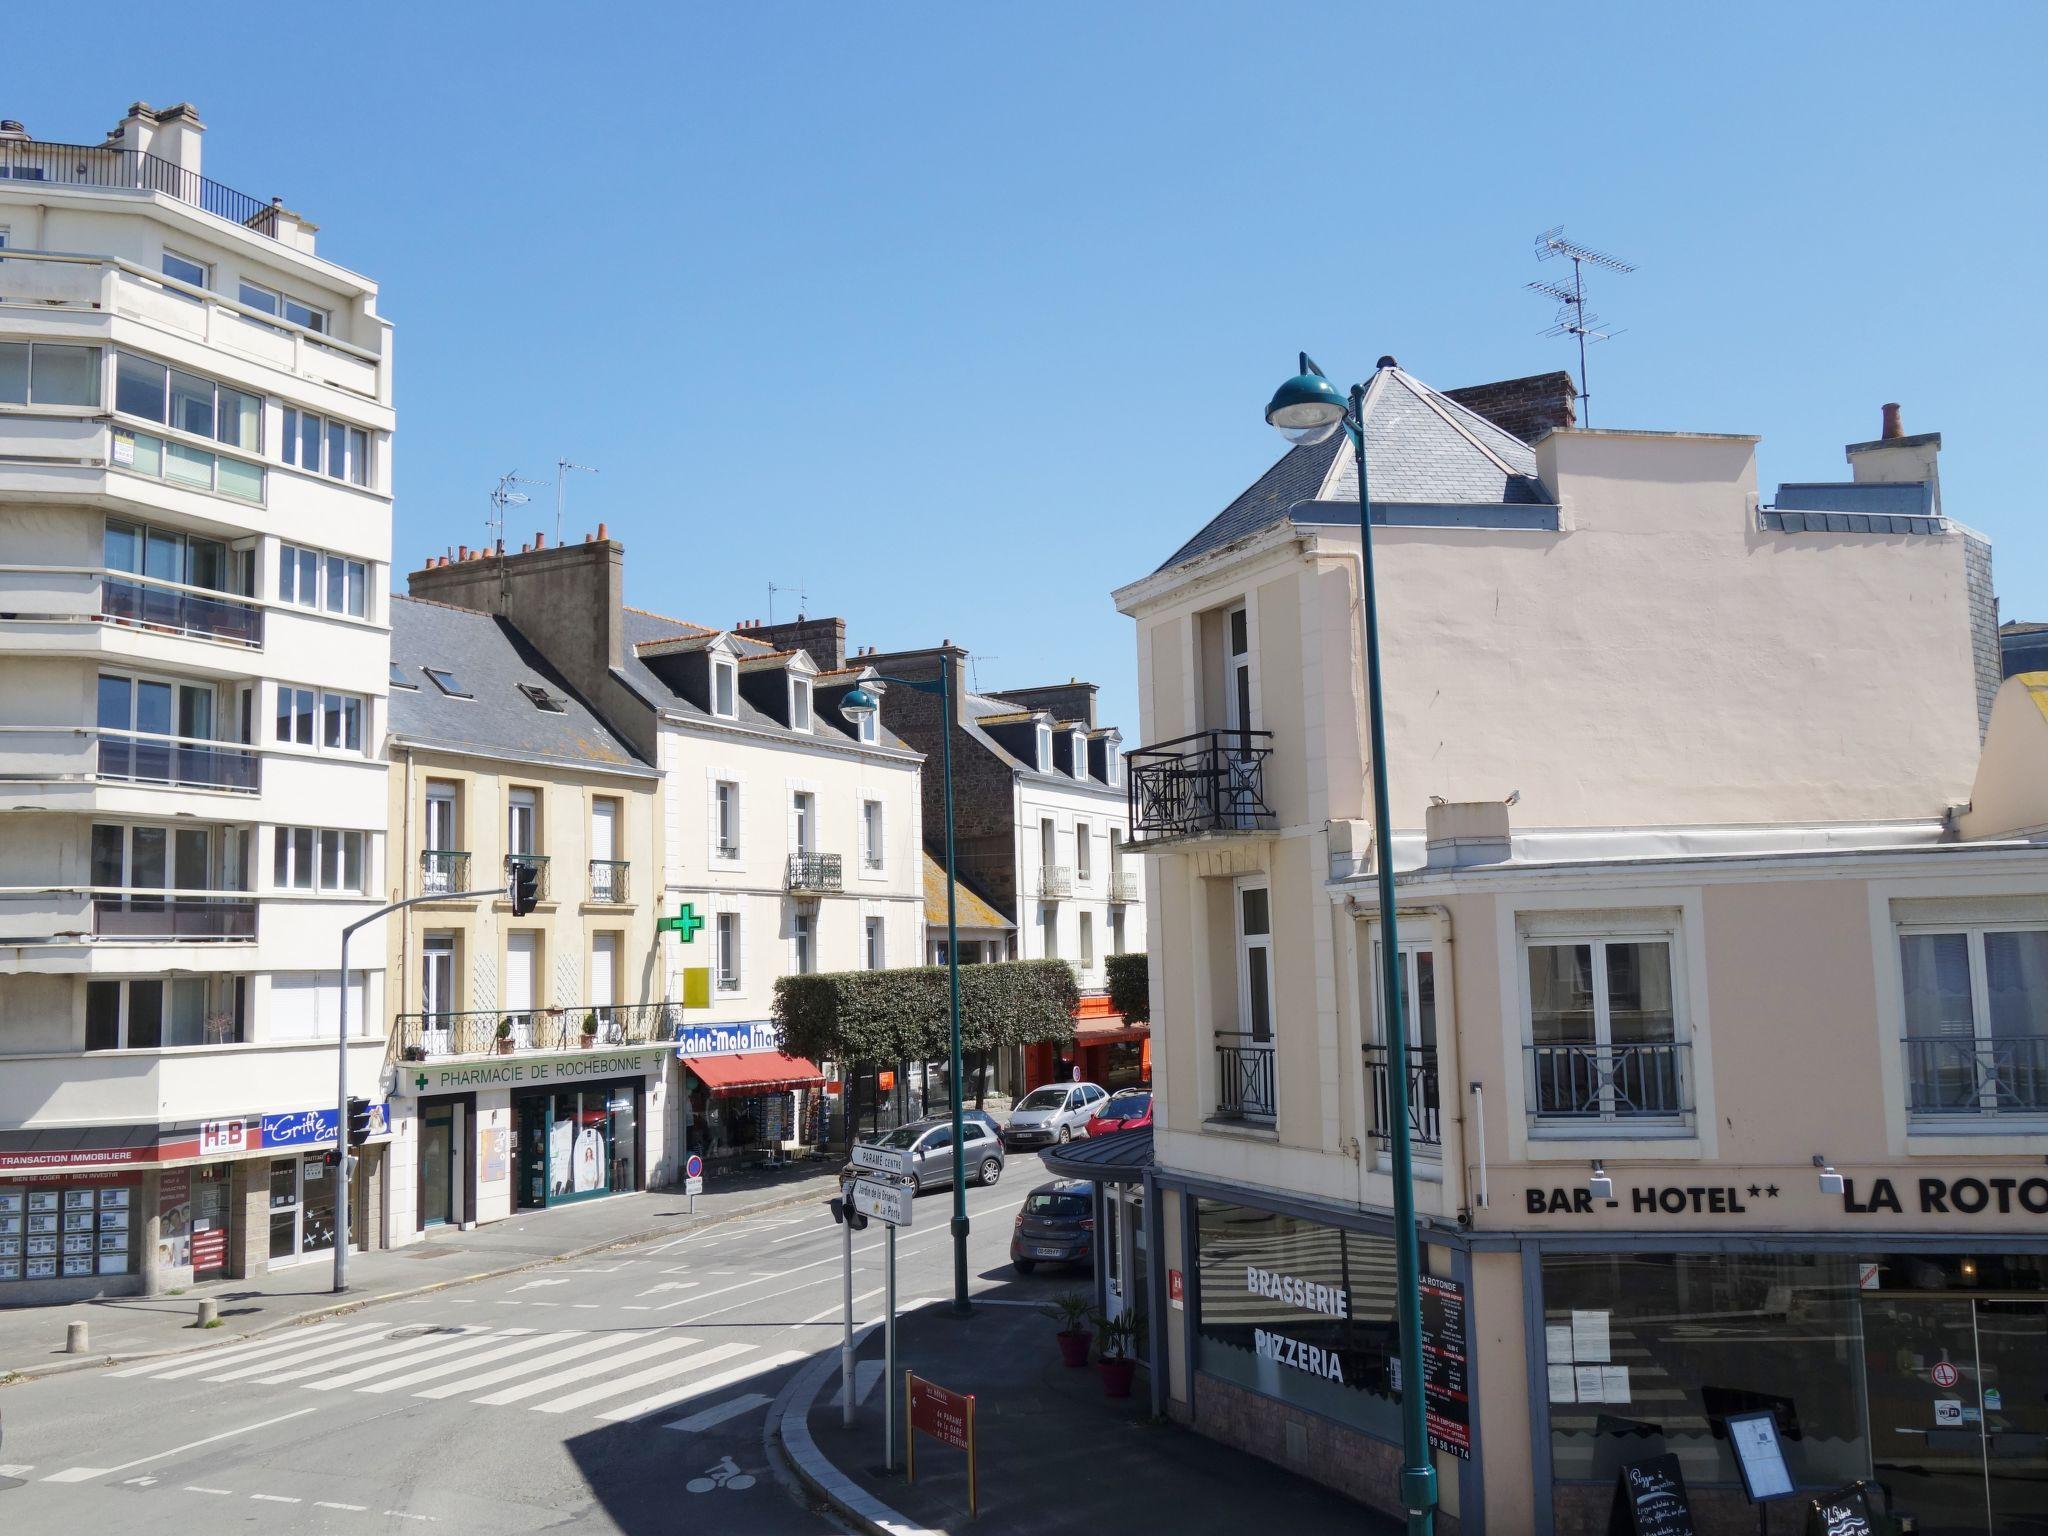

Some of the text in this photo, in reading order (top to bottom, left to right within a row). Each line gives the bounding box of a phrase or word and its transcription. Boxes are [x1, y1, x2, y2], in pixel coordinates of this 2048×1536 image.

[680, 1029, 749, 1054] Saint-Malo
[441, 1057, 642, 1087] PHARMACIE DE ROCHEBONNE
[205, 1121, 243, 1147] H2B
[263, 1111, 326, 1141] La Griffe
[1, 1152, 132, 1165] TRANSACTION IMMOBILIERE
[862, 1152, 901, 1170] PARAMÉ CENTRE
[39, 1174, 60, 1182] LOGER
[89, 1171, 119, 1179] INVESTIR
[871, 1187, 877, 1198] de
[1526, 1187, 1594, 1214] BAR
[1632, 1187, 1746, 1214] HOTEL
[1843, 1177, 2048, 1214] LA ROTO
[880, 1203, 886, 1215] La
[1174, 1276, 1182, 1289] H
[1246, 1265, 1348, 1319] BRASSERIE
[1418, 1275, 1427, 1284] LA
[1427, 1277, 1457, 1292] ROTONDE
[1254, 1327, 1344, 1384] PIZZERIA
[1440, 1417, 1463, 1431] EMPORTER
[1429, 1436, 1438, 1447] 99
[1450, 1445, 1458, 1455] 11
[1460, 1448, 1469, 1460] 74
